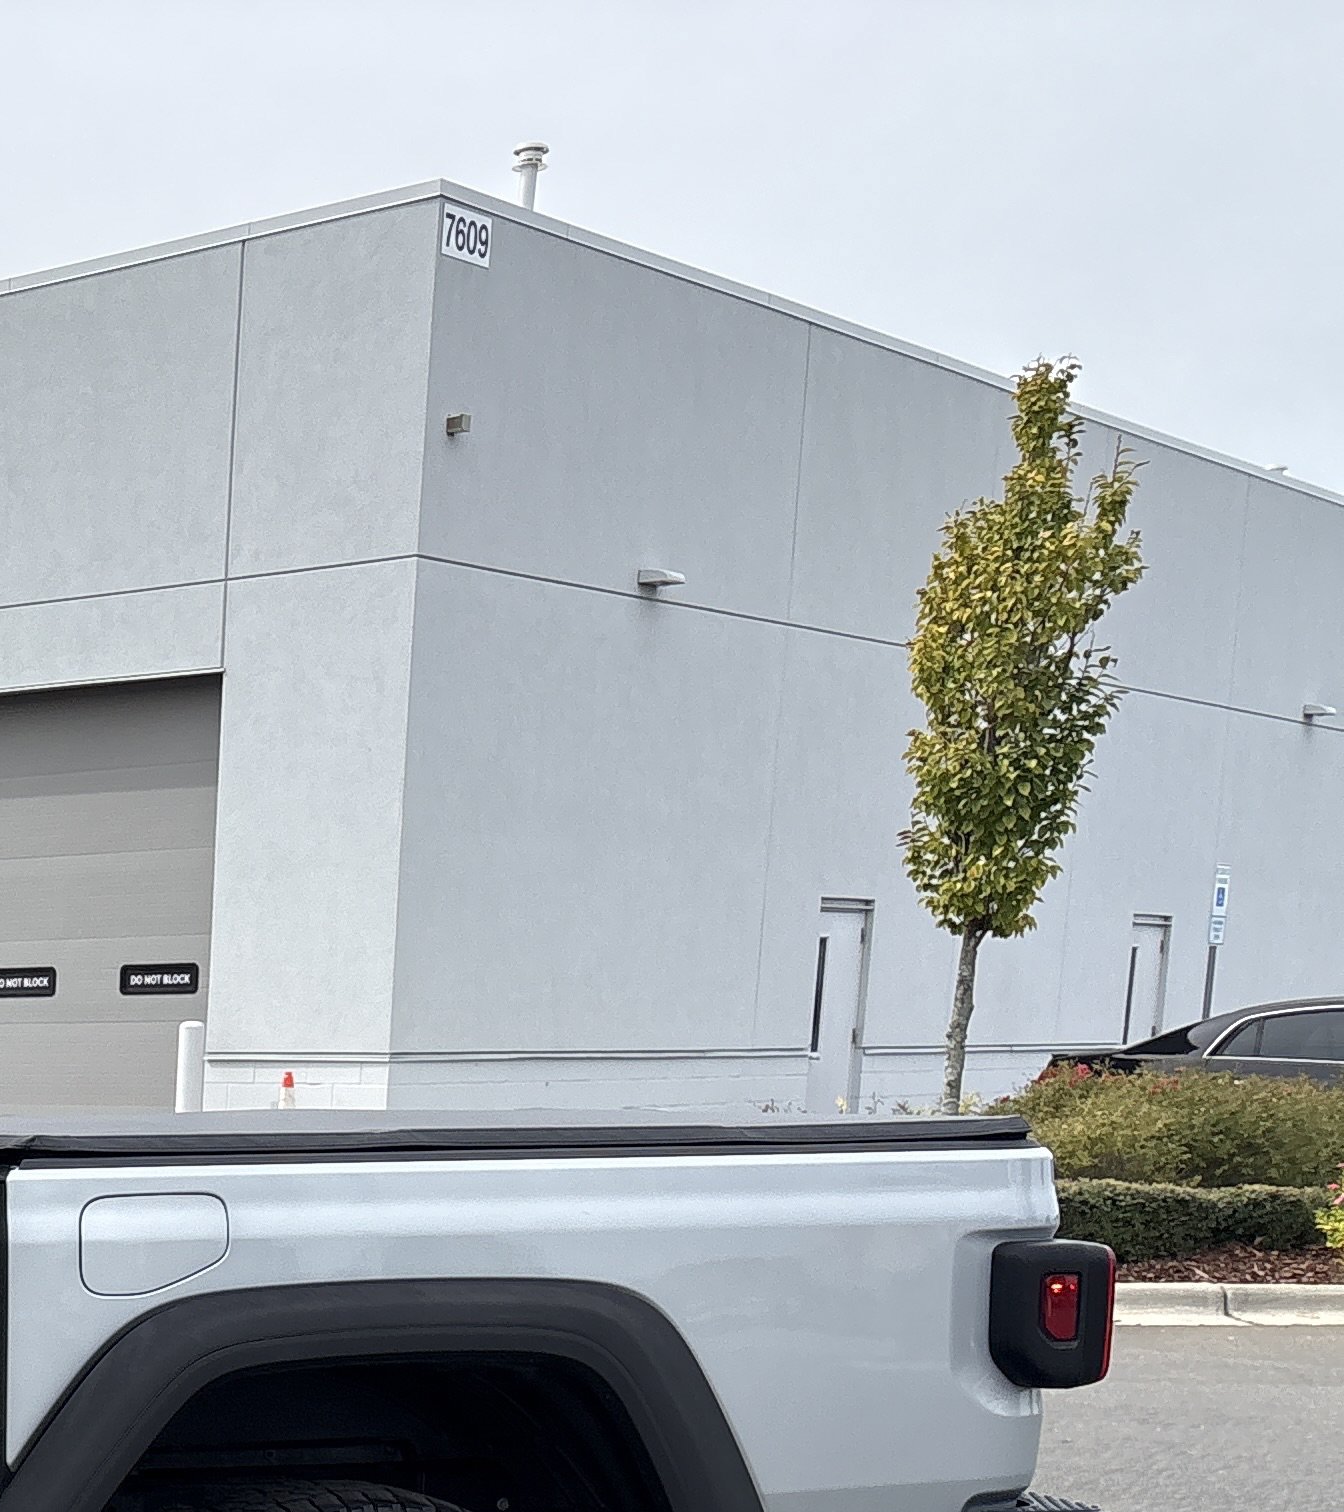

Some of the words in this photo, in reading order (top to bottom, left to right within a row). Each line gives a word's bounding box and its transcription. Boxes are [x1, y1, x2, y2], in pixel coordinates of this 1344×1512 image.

[445, 211, 489, 259] 7609
[5, 977, 22, 988] NOT
[23, 976, 50, 988] BLOCK
[130, 974, 143, 985] DO
[144, 974, 162, 985] NOT
[162, 973, 191, 985] BLOCK
